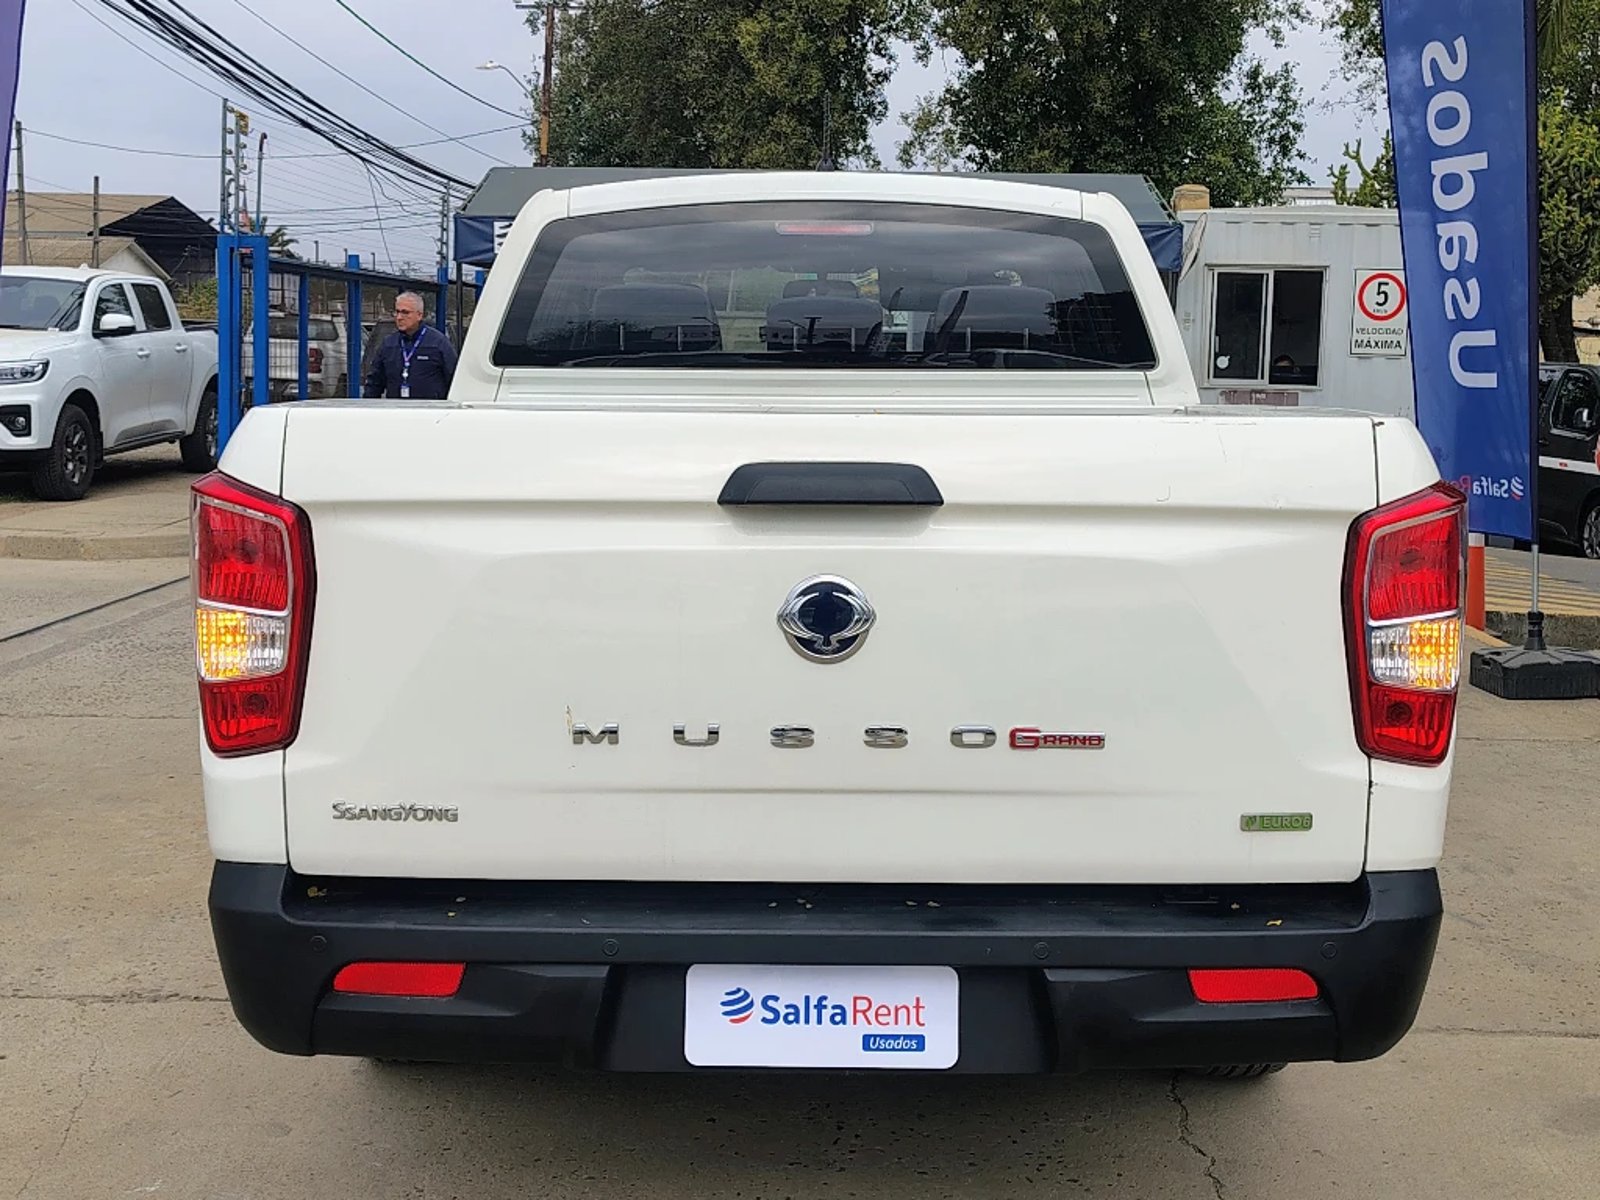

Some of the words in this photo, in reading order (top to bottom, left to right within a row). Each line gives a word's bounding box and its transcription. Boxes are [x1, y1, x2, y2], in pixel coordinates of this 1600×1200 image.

[1374, 281, 1390, 307] 5
[1355, 327, 1404, 336] VELOCIDAD
[1353, 337, 1403, 350] MÁXIMA
[571, 721, 998, 749] MUSSO
[1262, 815, 1312, 828] EURO6
[760, 995, 926, 1027] SalfaRent
[869, 1036, 919, 1050] Usados
